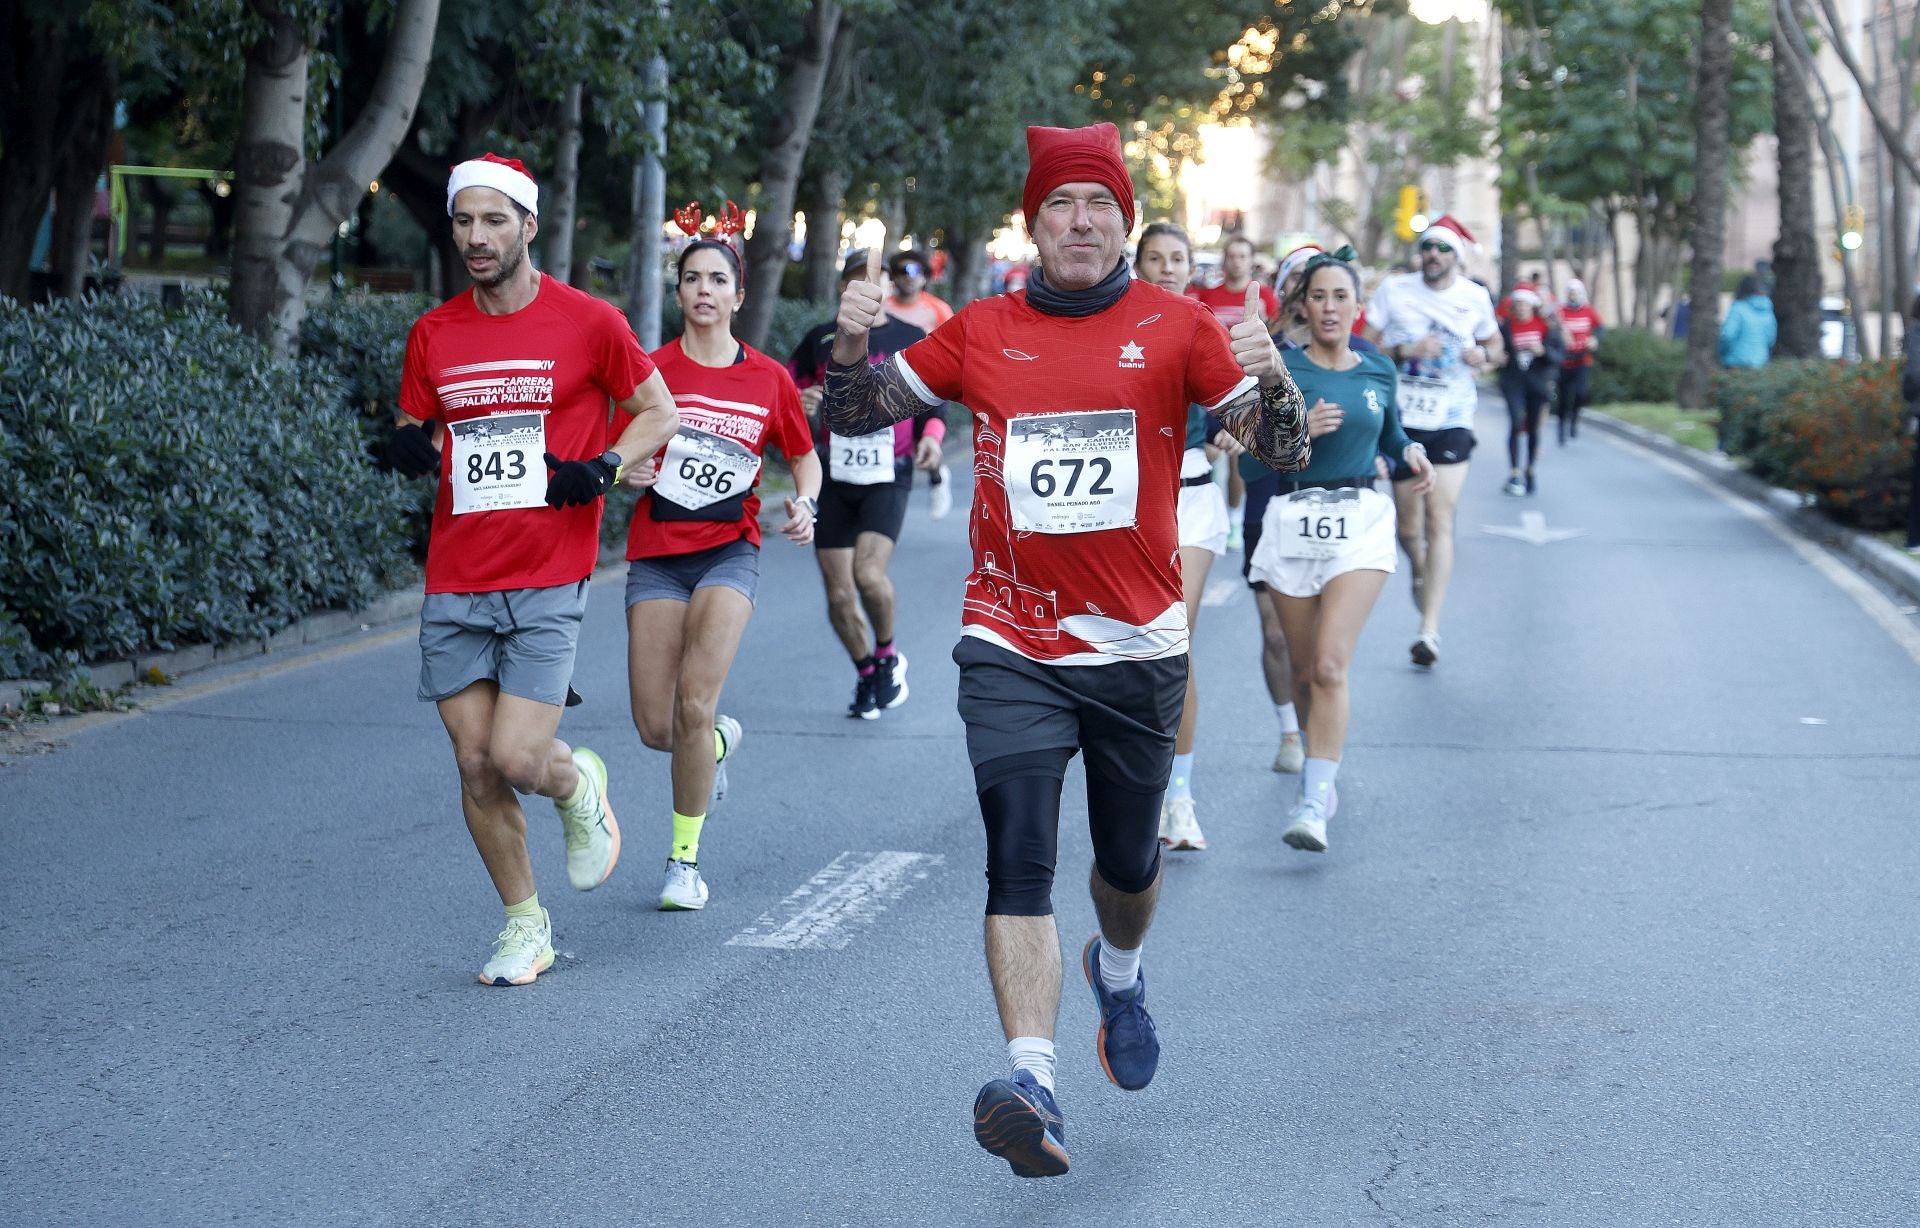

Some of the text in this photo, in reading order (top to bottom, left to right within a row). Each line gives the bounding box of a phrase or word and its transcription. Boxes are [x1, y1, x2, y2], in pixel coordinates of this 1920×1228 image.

[538, 360, 555, 370] XIV
[1118, 361, 1145, 369] luanvi
[502, 377, 553, 387] CARRERA
[485, 386, 553, 395] SAN SILVESTRE
[461, 393, 553, 407] PALMA PALMILLA
[717, 425, 759, 445] PALMILLA
[1094, 428, 1132, 438] XIV
[843, 449, 881, 467] 261
[467, 449, 526, 484] 843
[679, 457, 736, 494] 686
[1030, 457, 1114, 498] 672
[1298, 516, 1349, 539] 161
